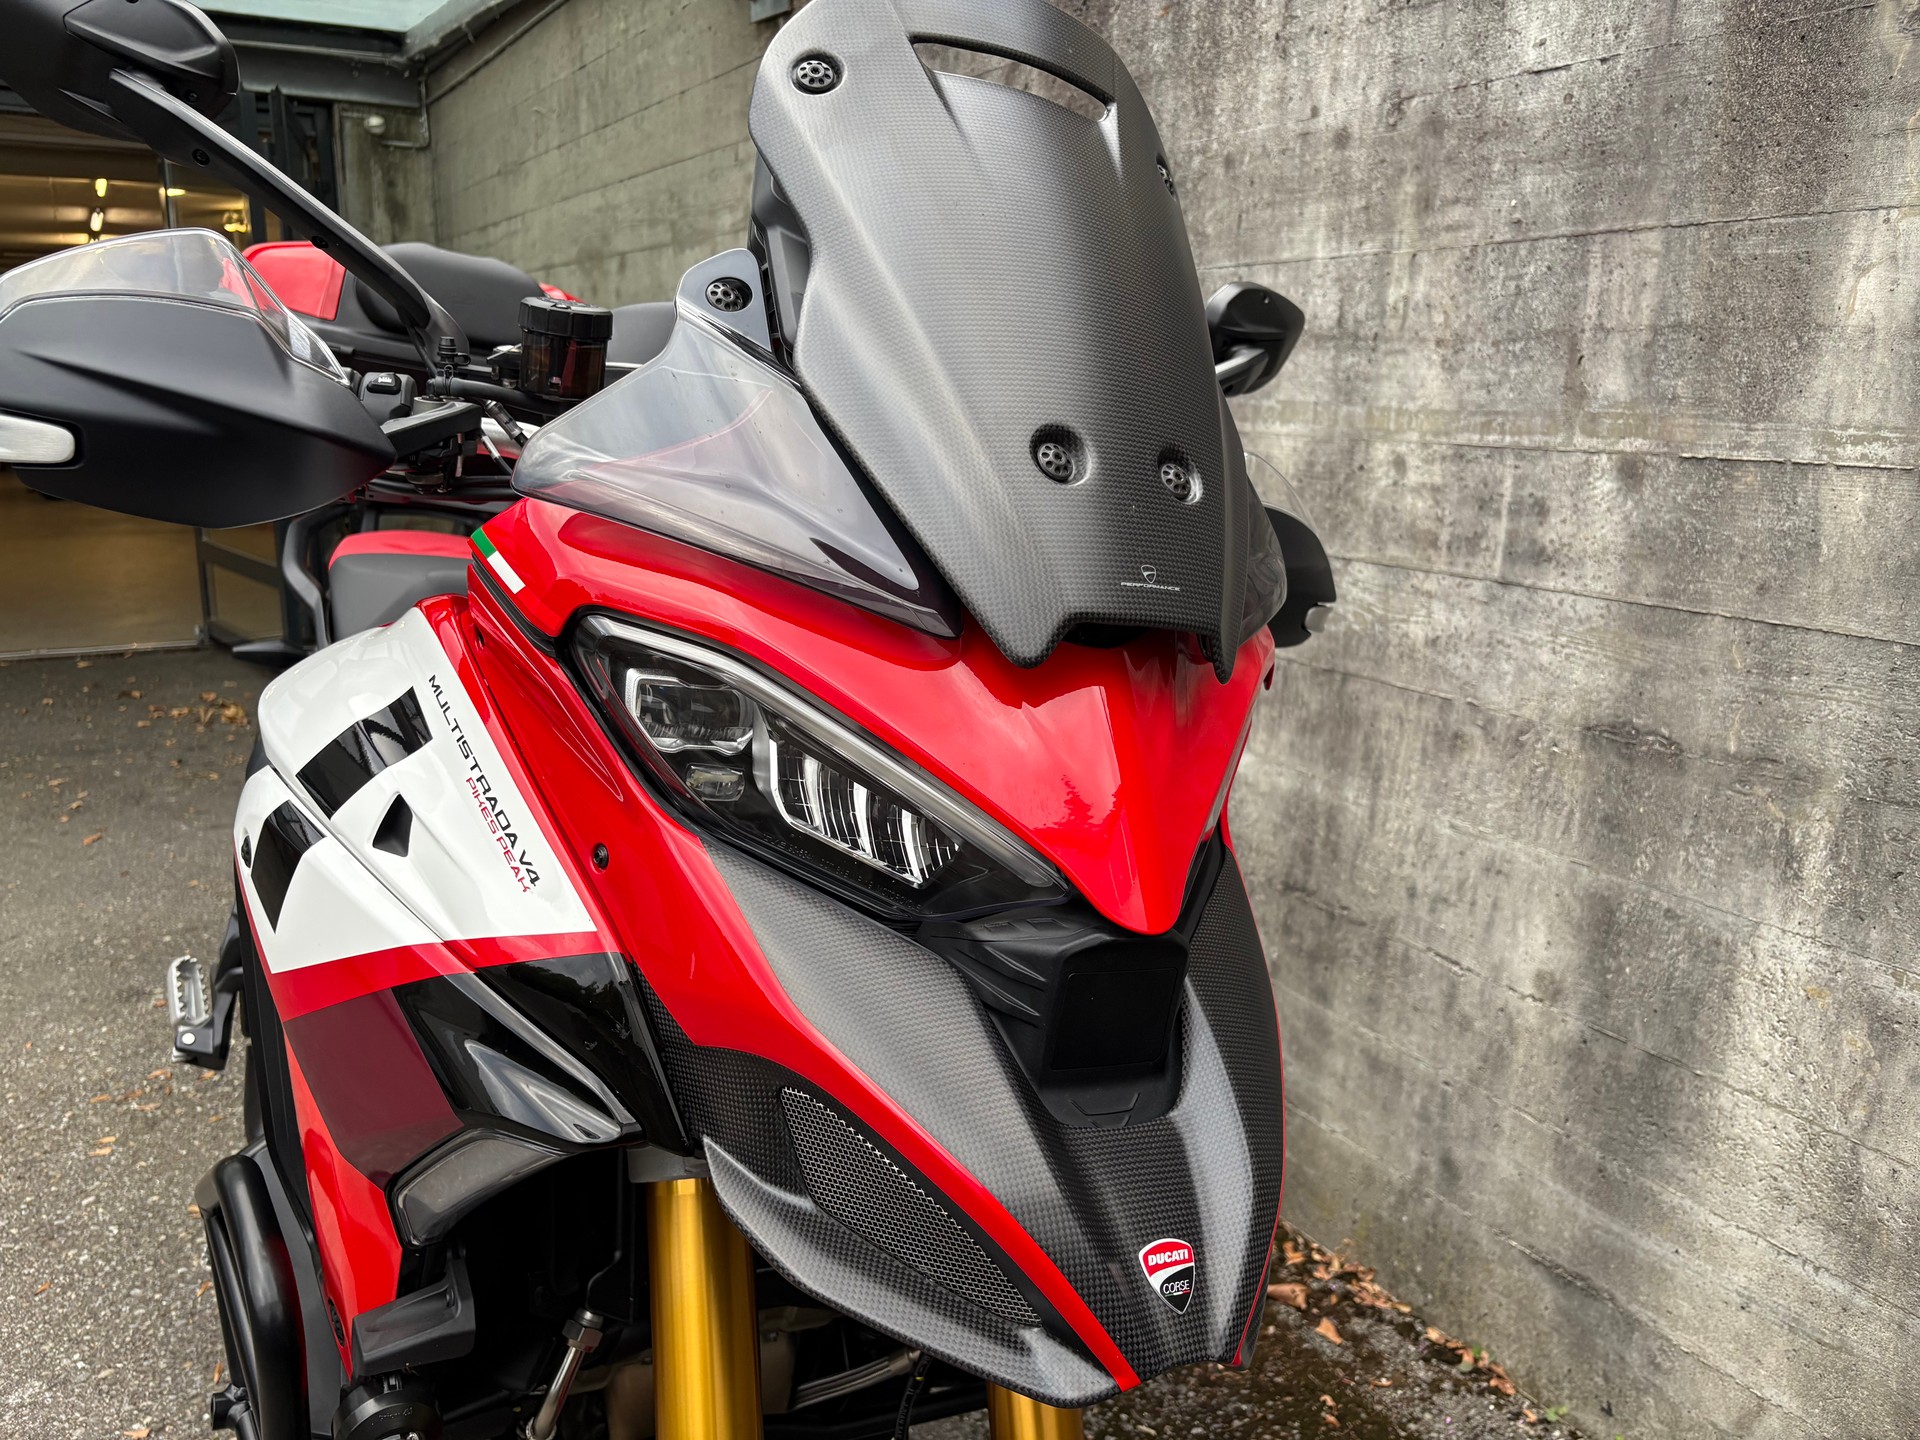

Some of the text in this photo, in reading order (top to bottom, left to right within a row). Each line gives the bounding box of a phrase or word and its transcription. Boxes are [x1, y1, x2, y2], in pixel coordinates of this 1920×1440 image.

[1120, 581, 1180, 592] PERFORMANCE
[428, 674, 541, 887] MULTISTRADA V4
[466, 777, 531, 893] PIKES PEAK
[1147, 1248, 1189, 1267] DUCATI
[1163, 1279, 1190, 1294] CORSE
